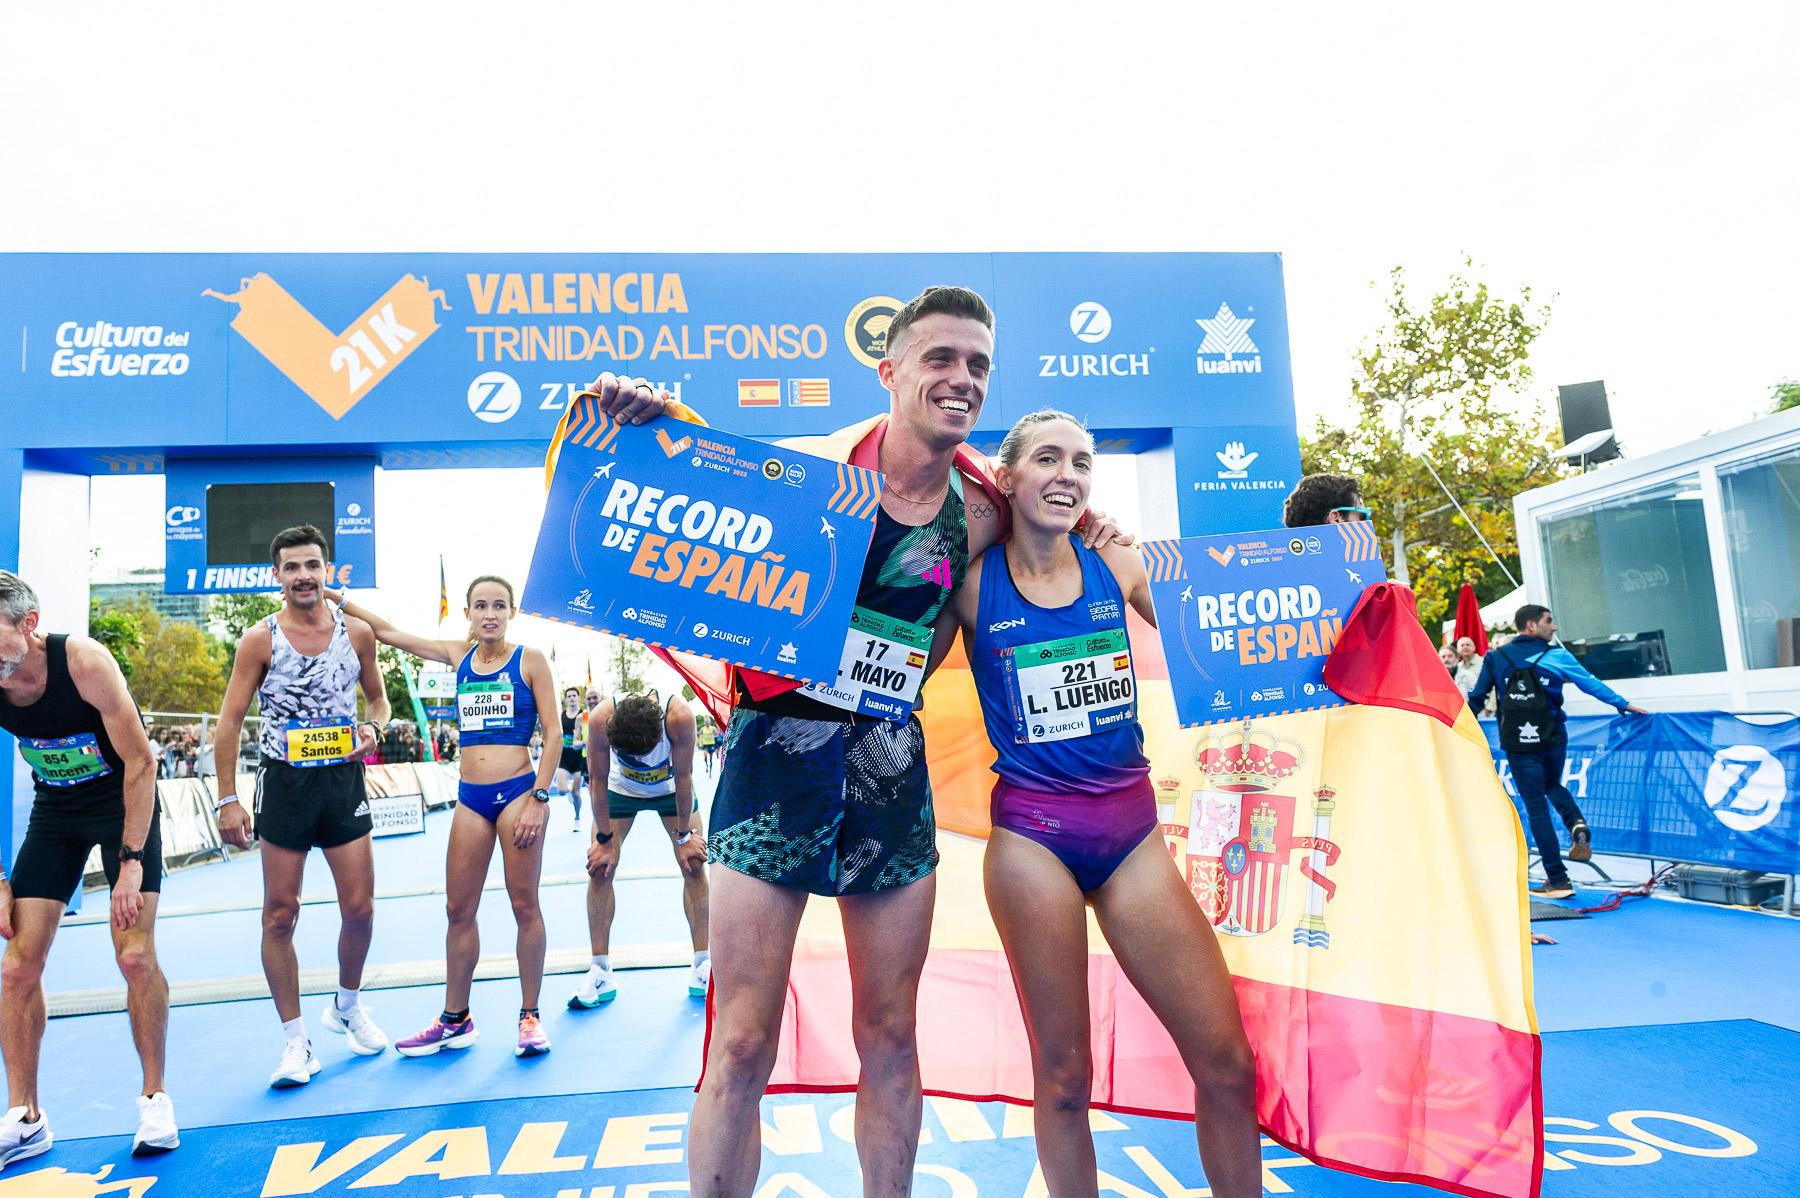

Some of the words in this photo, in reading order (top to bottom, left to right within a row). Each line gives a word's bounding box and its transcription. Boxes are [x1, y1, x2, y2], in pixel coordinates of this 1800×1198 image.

[466, 273, 689, 314] VALENCIA
[55, 321, 163, 348] Cultura
[163, 331, 190, 347] del
[465, 325, 645, 362] TRINIDAD
[648, 324, 828, 360] ALFONSO
[329, 302, 417, 394] 21K
[51, 348, 190, 377] Esfuerzo
[1038, 353, 1150, 378] ZURICH
[1197, 355, 1262, 374] luanvi
[697, 438, 736, 456] VALENCIA
[703, 461, 730, 473] ZURICH
[1194, 482, 1227, 491] FERIA
[1231, 480, 1286, 490] VALENCIA
[338, 517, 371, 525] ZURICH
[600, 478, 773, 554] RECORD
[186, 568, 197, 590] 1
[204, 566, 282, 589] FINISH
[601, 522, 640, 552] DE
[628, 532, 811, 617] ESPAÑA
[1198, 585, 1321, 629] RECORD
[637, 618, 665, 629] ALFONSO
[639, 613, 667, 624] TRINIDAD
[711, 629, 751, 646] ZURICH
[1211, 630, 1235, 652] DE
[1238, 608, 1344, 665] ESPAÑ
[865, 640, 890, 661] 17
[850, 660, 907, 692] MAYO
[1062, 661, 1097, 684] 221
[474, 694, 493, 704] 228
[819, 685, 855, 702] ZURICH
[1027, 695, 1048, 715] L.
[1054, 677, 1131, 711] LUENGO
[462, 705, 508, 717] GODINHO
[865, 698, 894, 713] luanvi
[1049, 720, 1084, 734] ZURICH
[1096, 712, 1124, 726] luanvi
[303, 731, 339, 743] 24538
[43, 753, 69, 764] 854
[301, 746, 342, 757] Santos
[373, 810, 418, 820] RINIDAD
[374, 818, 418, 828] LFONSO
